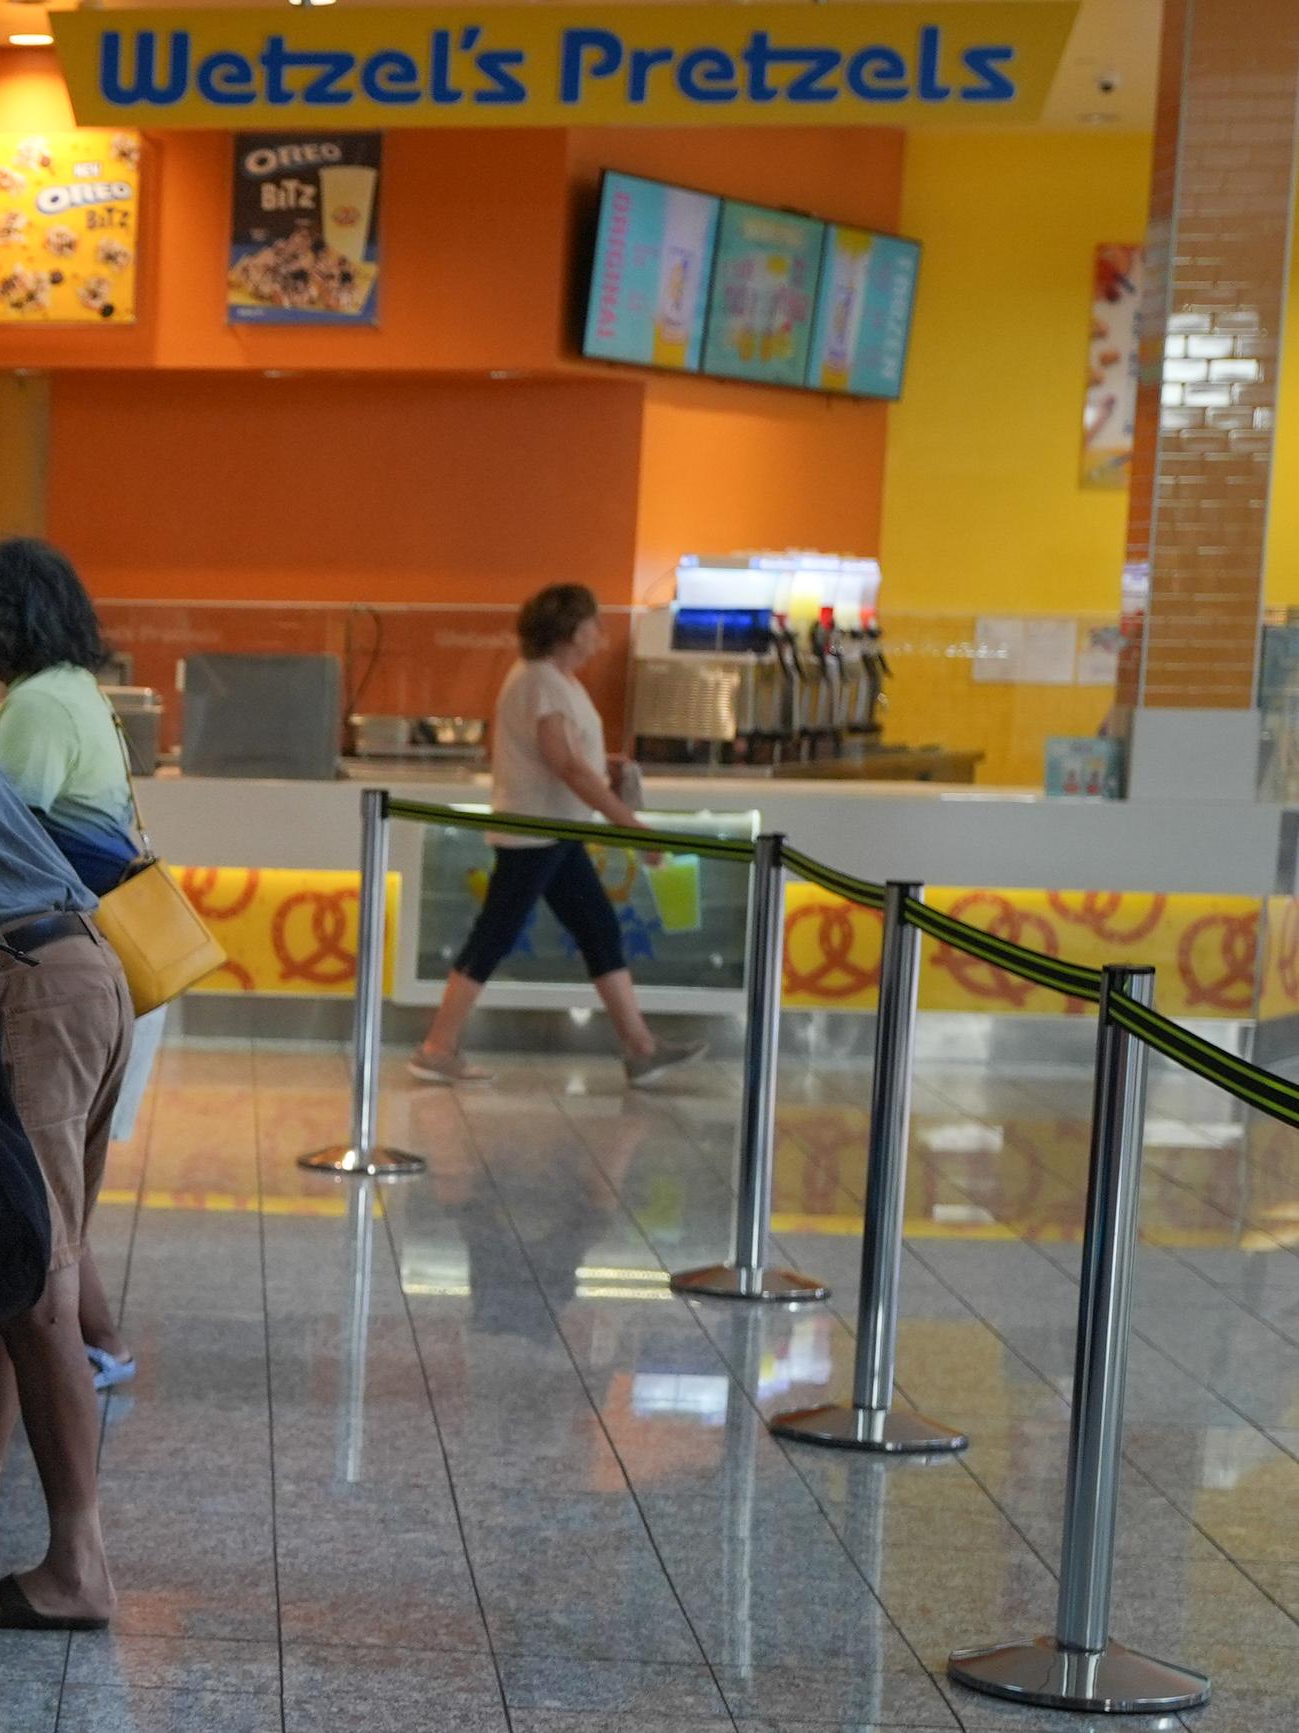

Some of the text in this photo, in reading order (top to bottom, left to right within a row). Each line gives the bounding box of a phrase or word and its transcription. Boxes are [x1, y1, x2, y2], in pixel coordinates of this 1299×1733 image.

[99, 24, 1017, 105] Wetzel's Pretzels
[244, 142, 342, 175] OREO
[35, 181, 133, 215] OREO
